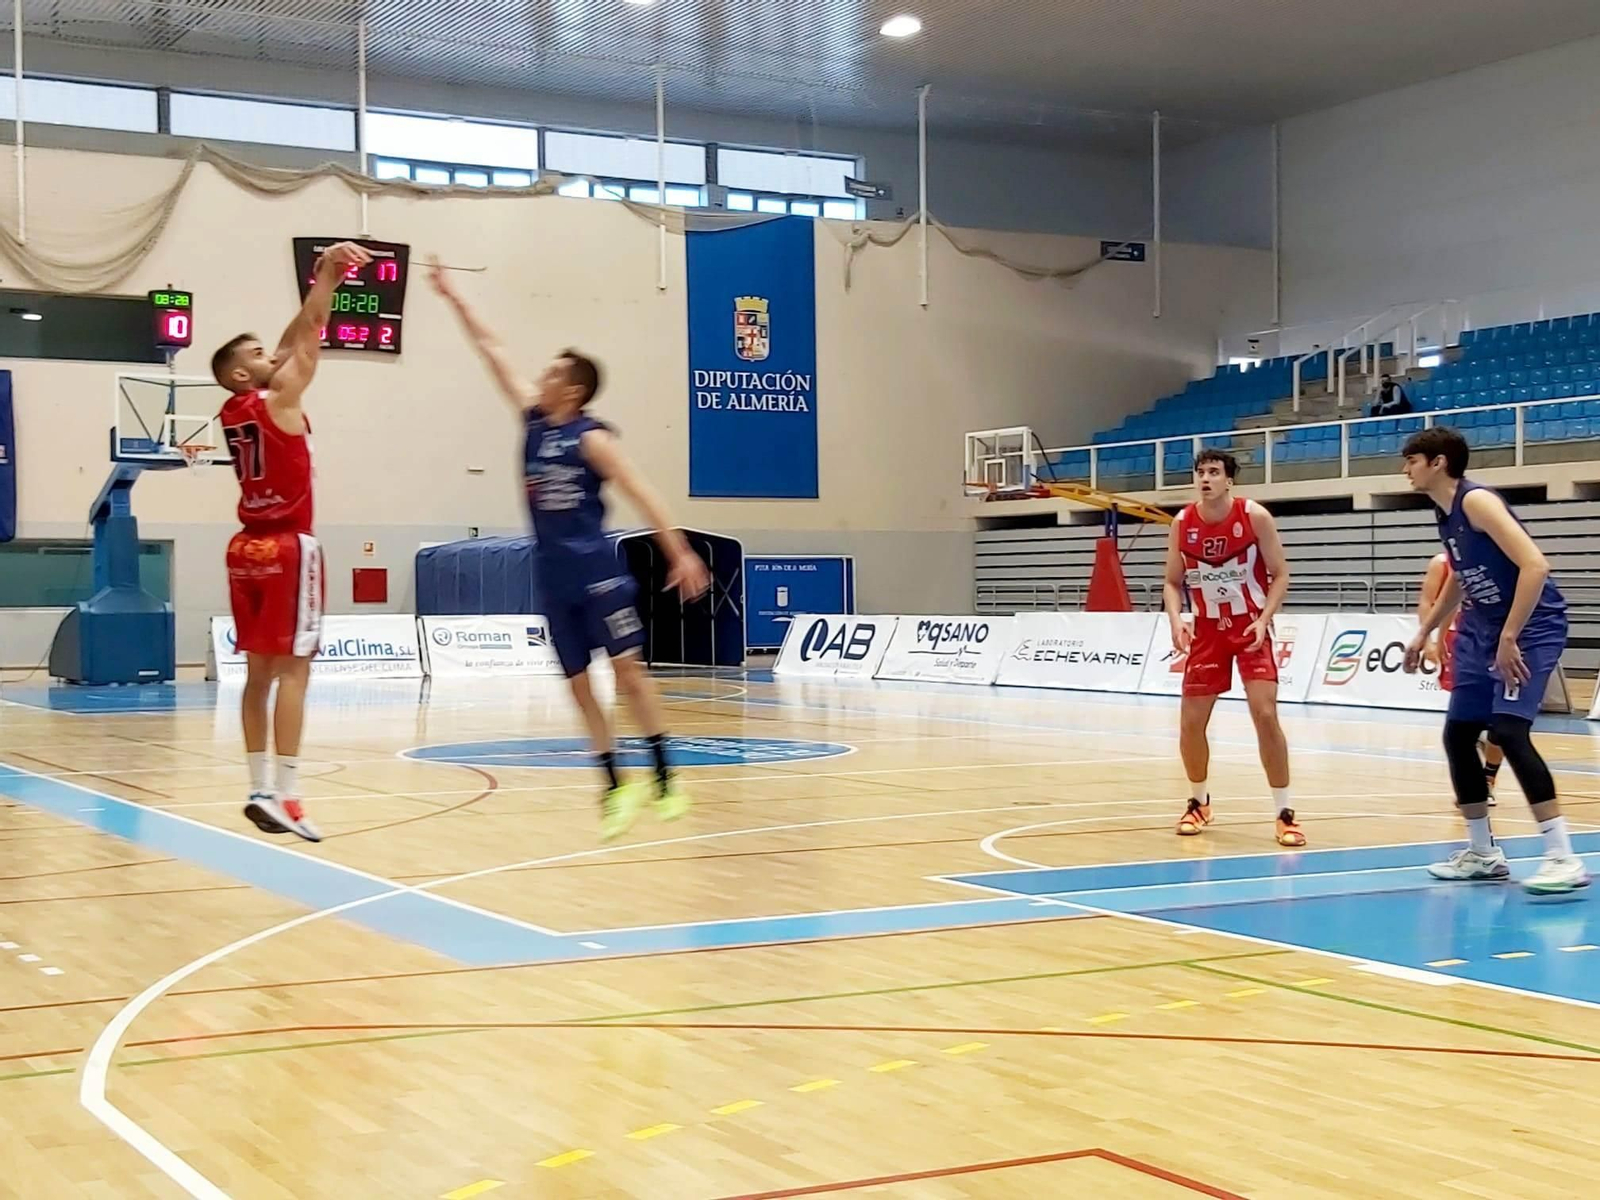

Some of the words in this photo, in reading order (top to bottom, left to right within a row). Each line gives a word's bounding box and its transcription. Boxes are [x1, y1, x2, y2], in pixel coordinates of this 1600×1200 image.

[154, 294, 189, 306] 08:28
[168, 316, 188, 338] 10
[381, 327, 393, 343] 2
[693, 369, 811, 391] DIPUTACIÓN
[696, 391, 722, 409] DE
[726, 391, 810, 412] ALMERÍA
[1202, 536, 1228, 558] 27
[455, 631, 512, 642] Roman
[1036, 639, 1084, 648] LABORATORIO
[1033, 650, 1144, 665] ECHEVARNE
